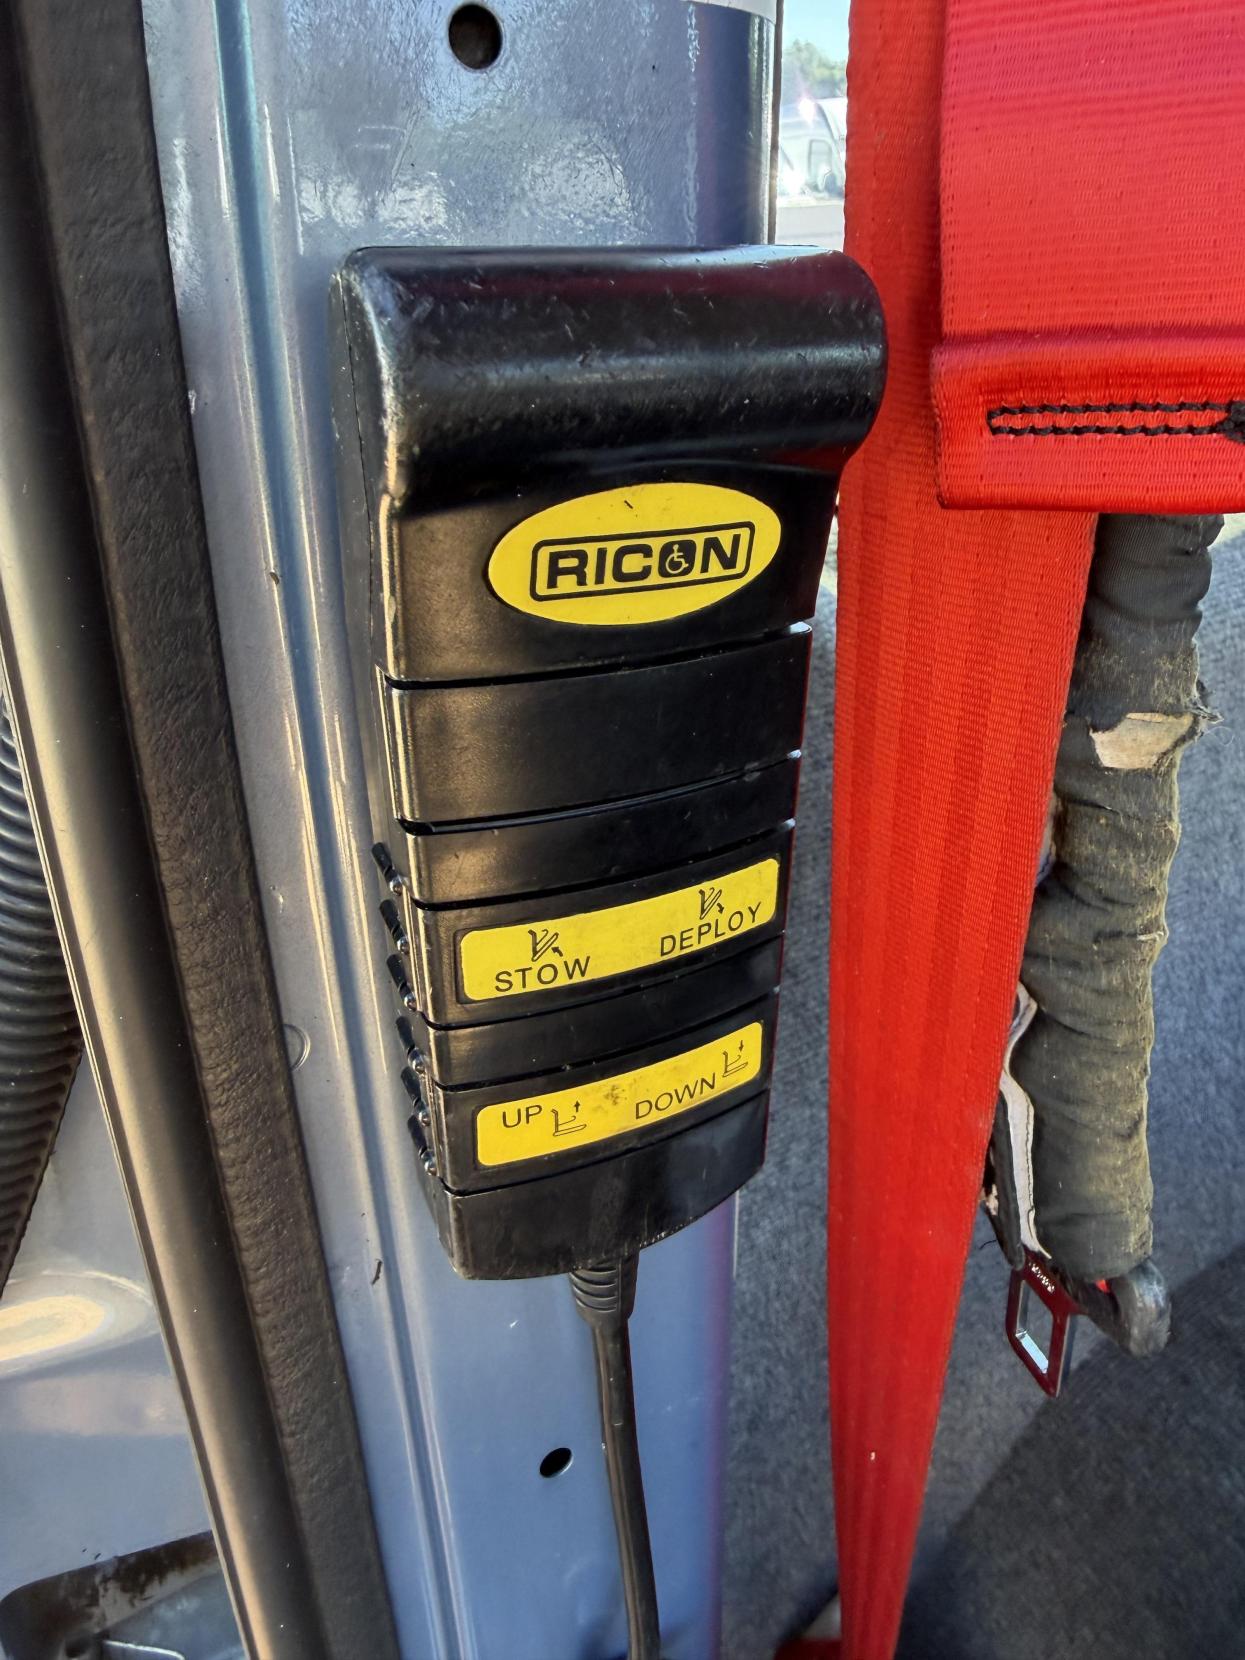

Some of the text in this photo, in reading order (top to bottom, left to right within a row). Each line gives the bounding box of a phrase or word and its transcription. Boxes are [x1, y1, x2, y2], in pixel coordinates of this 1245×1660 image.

[546, 534, 741, 589] RICON
[494, 901, 762, 992] STOW DEPLOY
[502, 1073, 716, 1128] UP DOWN
